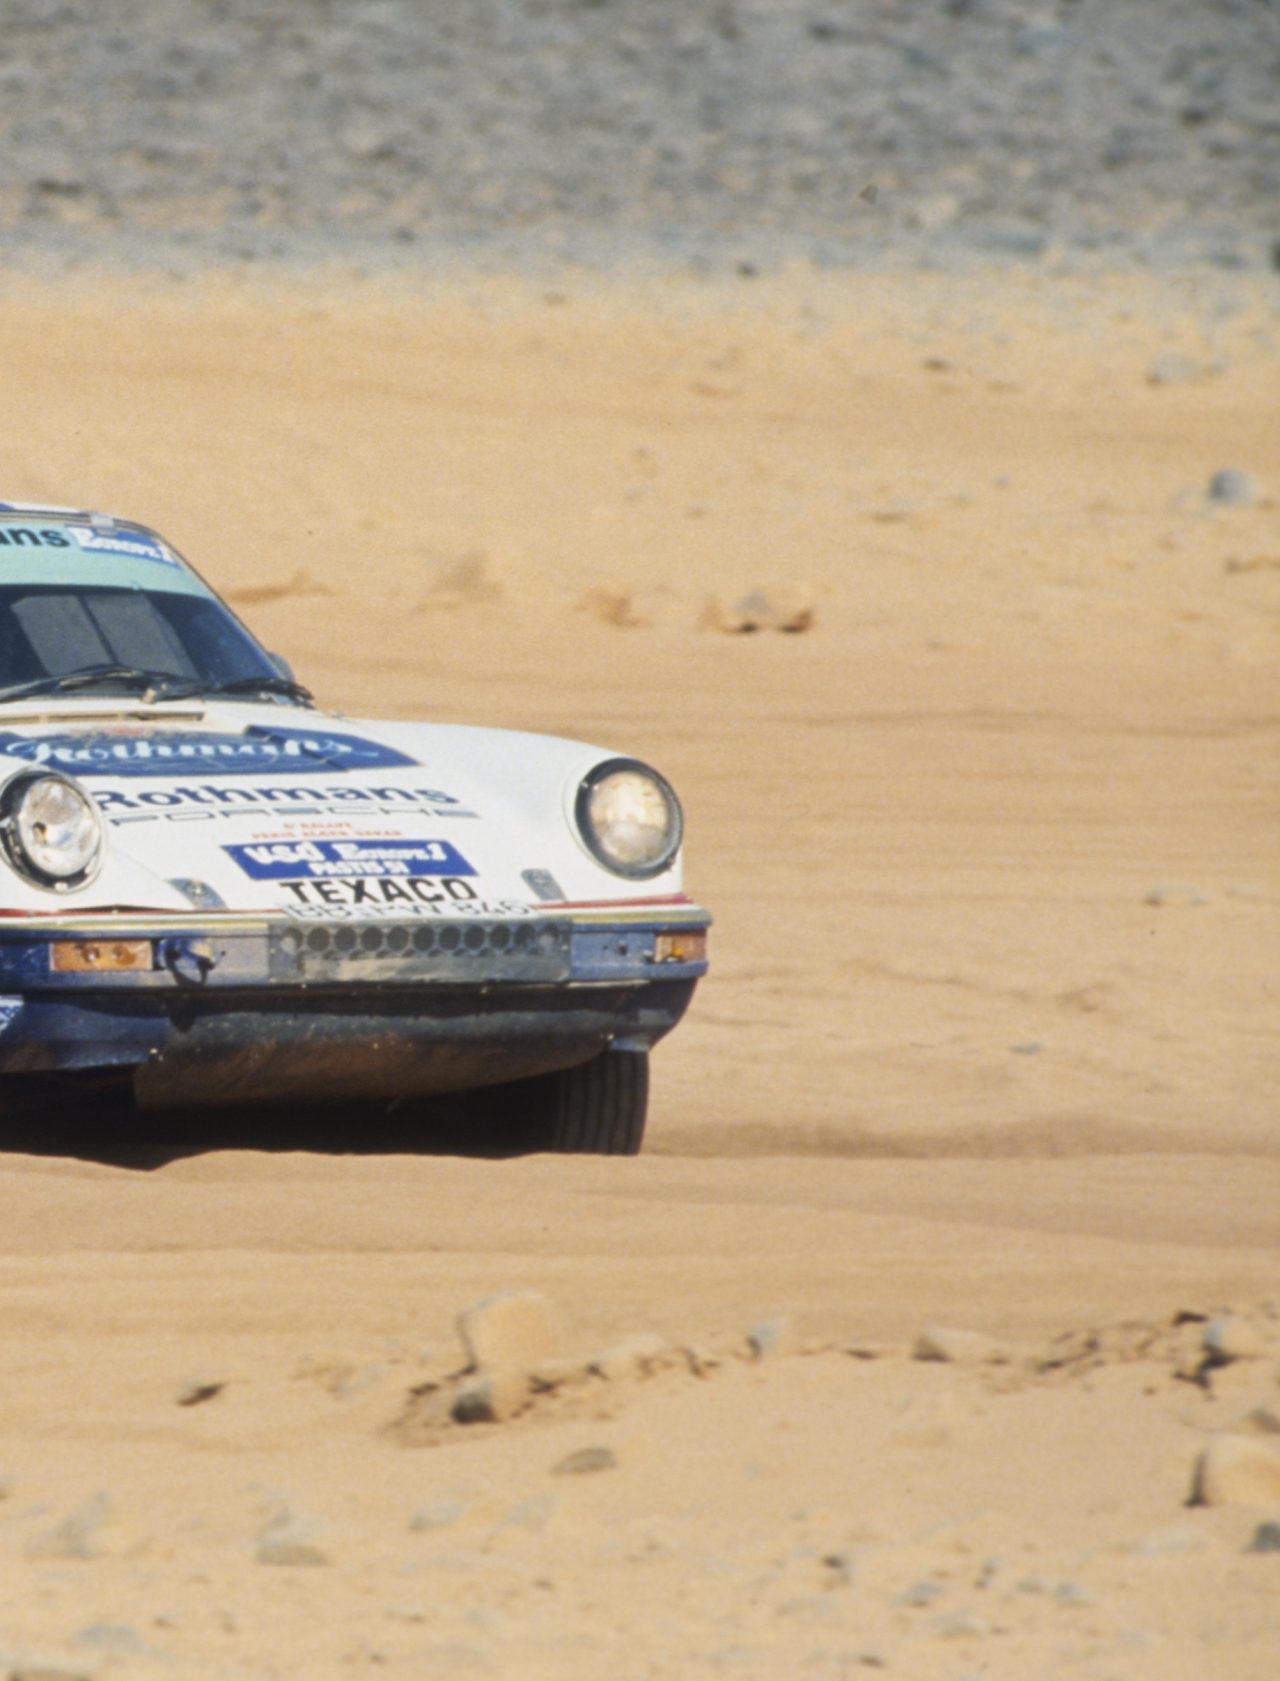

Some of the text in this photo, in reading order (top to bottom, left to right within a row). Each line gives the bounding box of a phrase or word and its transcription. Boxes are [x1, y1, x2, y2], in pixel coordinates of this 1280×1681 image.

[90, 785, 462, 812] Rothmans
[108, 806, 483, 827] PORSCHE
[279, 877, 480, 905] TEXACO
